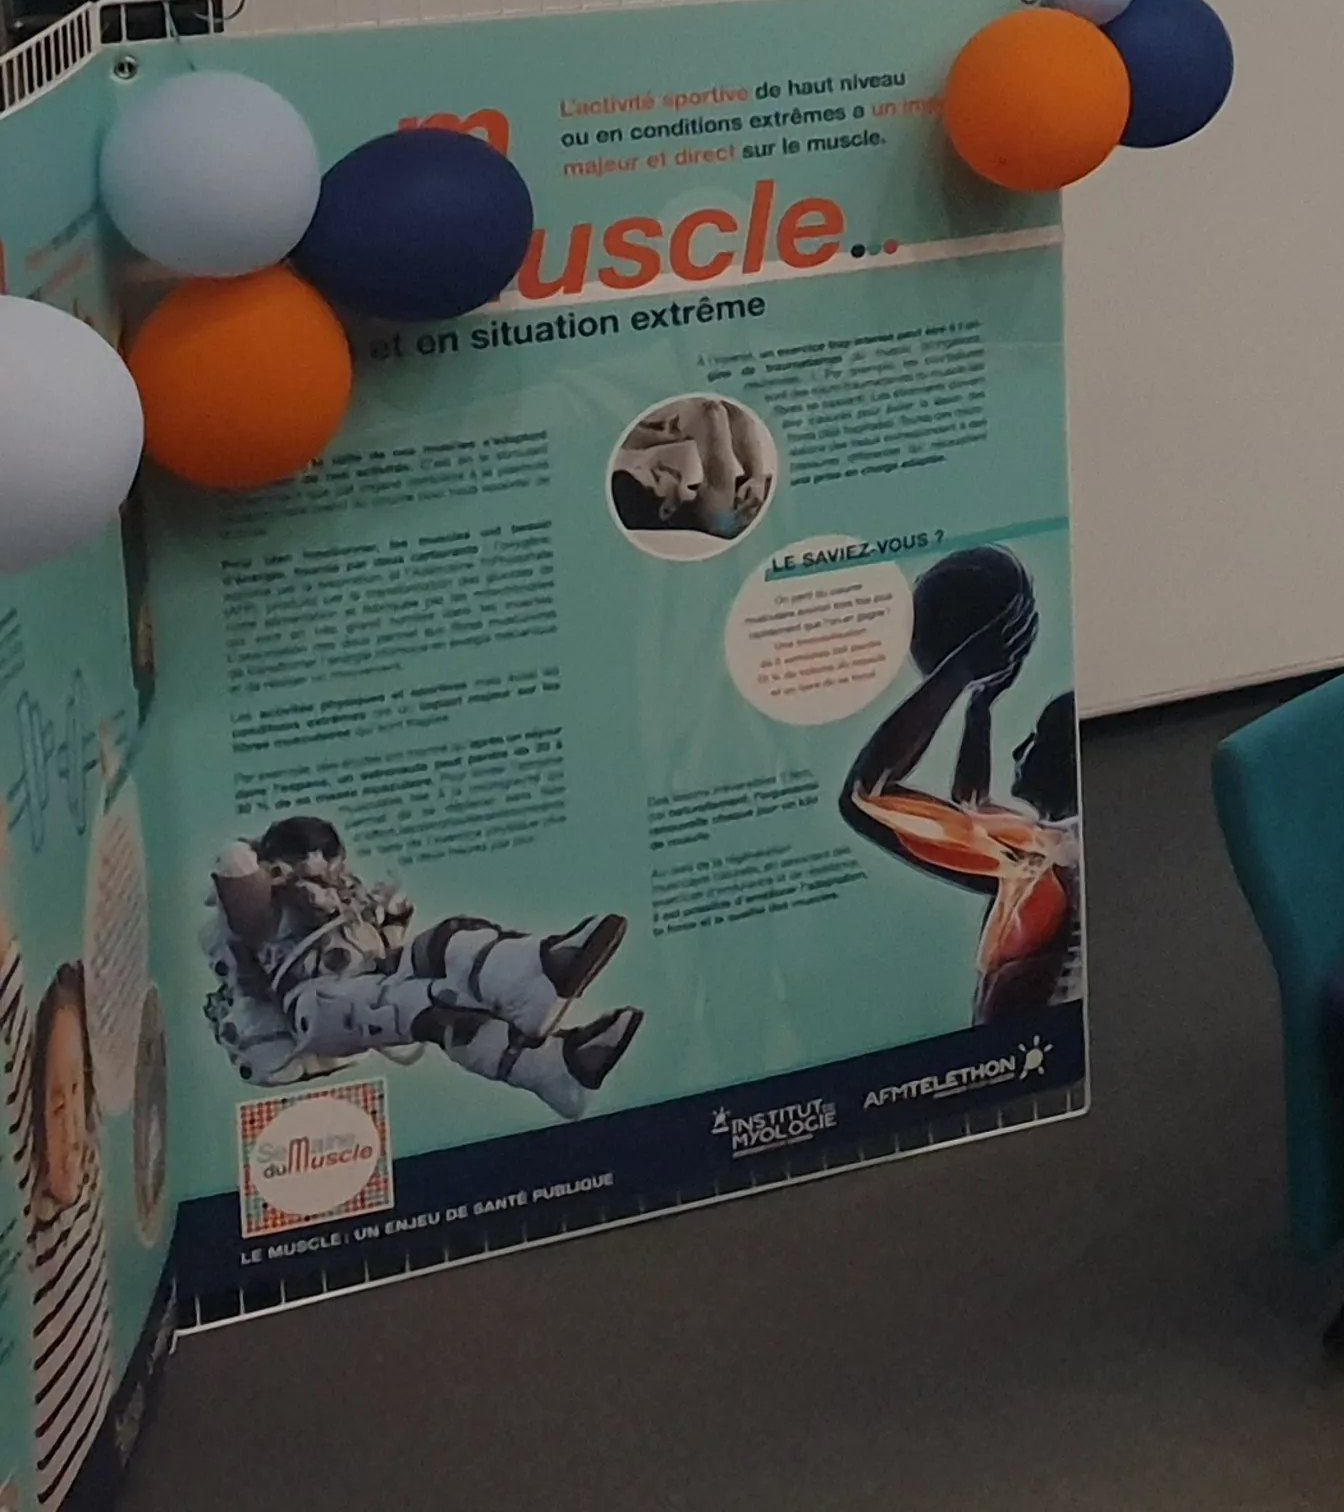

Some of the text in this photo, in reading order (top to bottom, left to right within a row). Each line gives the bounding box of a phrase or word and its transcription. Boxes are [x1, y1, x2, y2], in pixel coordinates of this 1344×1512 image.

[663, 86, 748, 112] sportive
[755, 79, 781, 100] de
[787, 75, 833, 96] haut
[839, 71, 906, 94] niveau
[561, 130, 590, 148] ou
[596, 126, 622, 145] en
[630, 113, 743, 143] conditions
[749, 103, 846, 130] extrêmes
[563, 128, 886, 178] majeur et direct sur le muscle.
[416, 329, 459, 357] en
[470, 307, 620, 351] situation
[631, 291, 767, 333] extrême
[772, 556, 796, 573] LE
[802, 532, 929, 569] SAVIEZ-VOUS
[731, 1098, 823, 1135] INSTITUT
[241, 1248, 262, 1265] LE
[268, 1232, 342, 1260] MUSCLE
[355, 1224, 379, 1241] UN
[384, 1212, 440, 1234] ENJEU
[446, 1205, 467, 1221] DE
[473, 1191, 527, 1215] SANTÉ
[532, 1172, 614, 1204] PUBLIQUE
